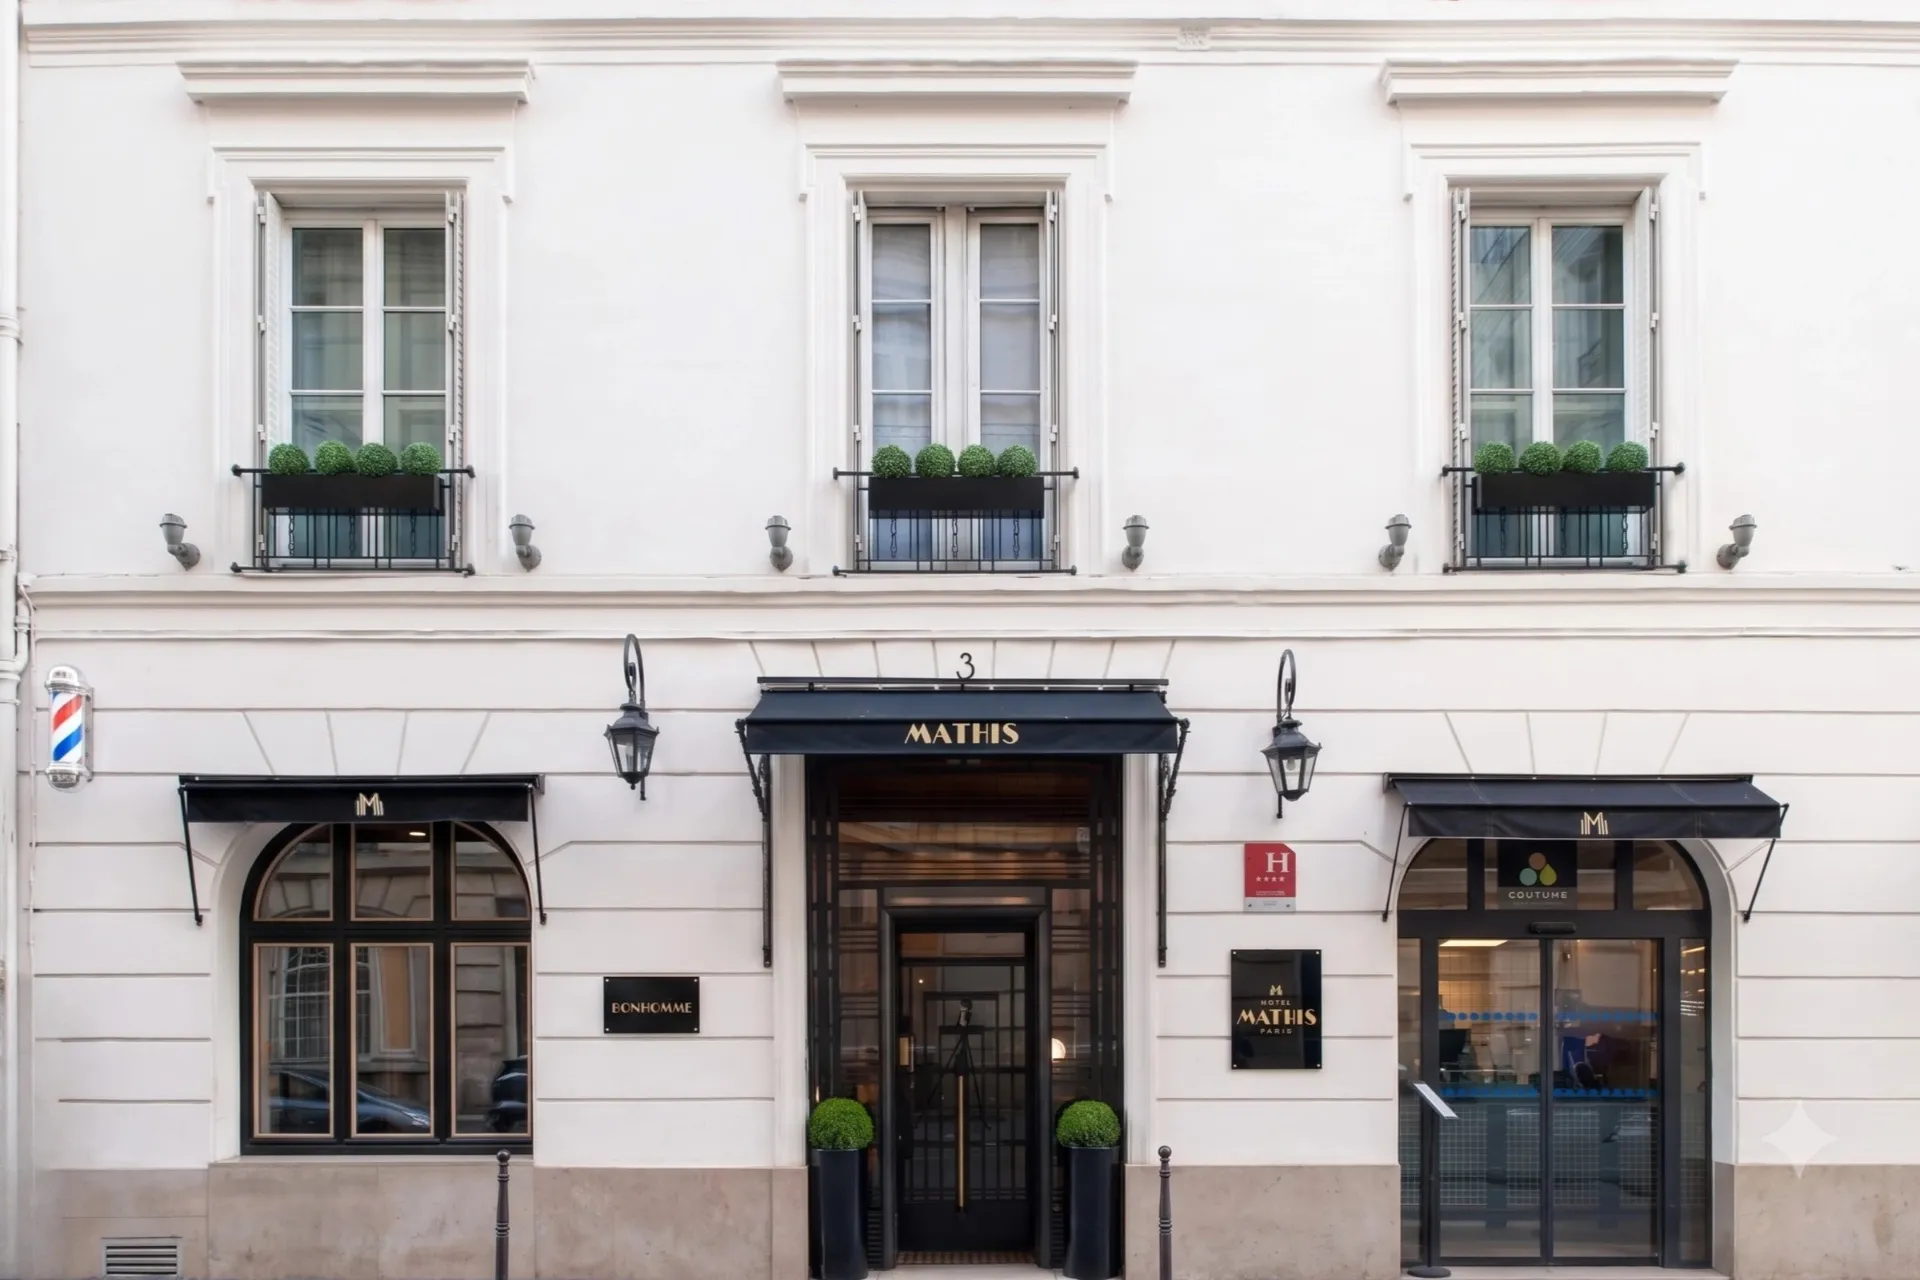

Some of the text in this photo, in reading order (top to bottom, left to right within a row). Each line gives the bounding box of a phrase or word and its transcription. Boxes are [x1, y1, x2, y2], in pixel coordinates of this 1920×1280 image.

[956, 652, 975, 680] 3
[904, 722, 1020, 745] MATHIS
[1265, 852, 1290, 873] H
[1508, 891, 1568, 899] COUTUME
[611, 1002, 692, 1013] BONHOMME
[1236, 1008, 1317, 1025] MATHIS
